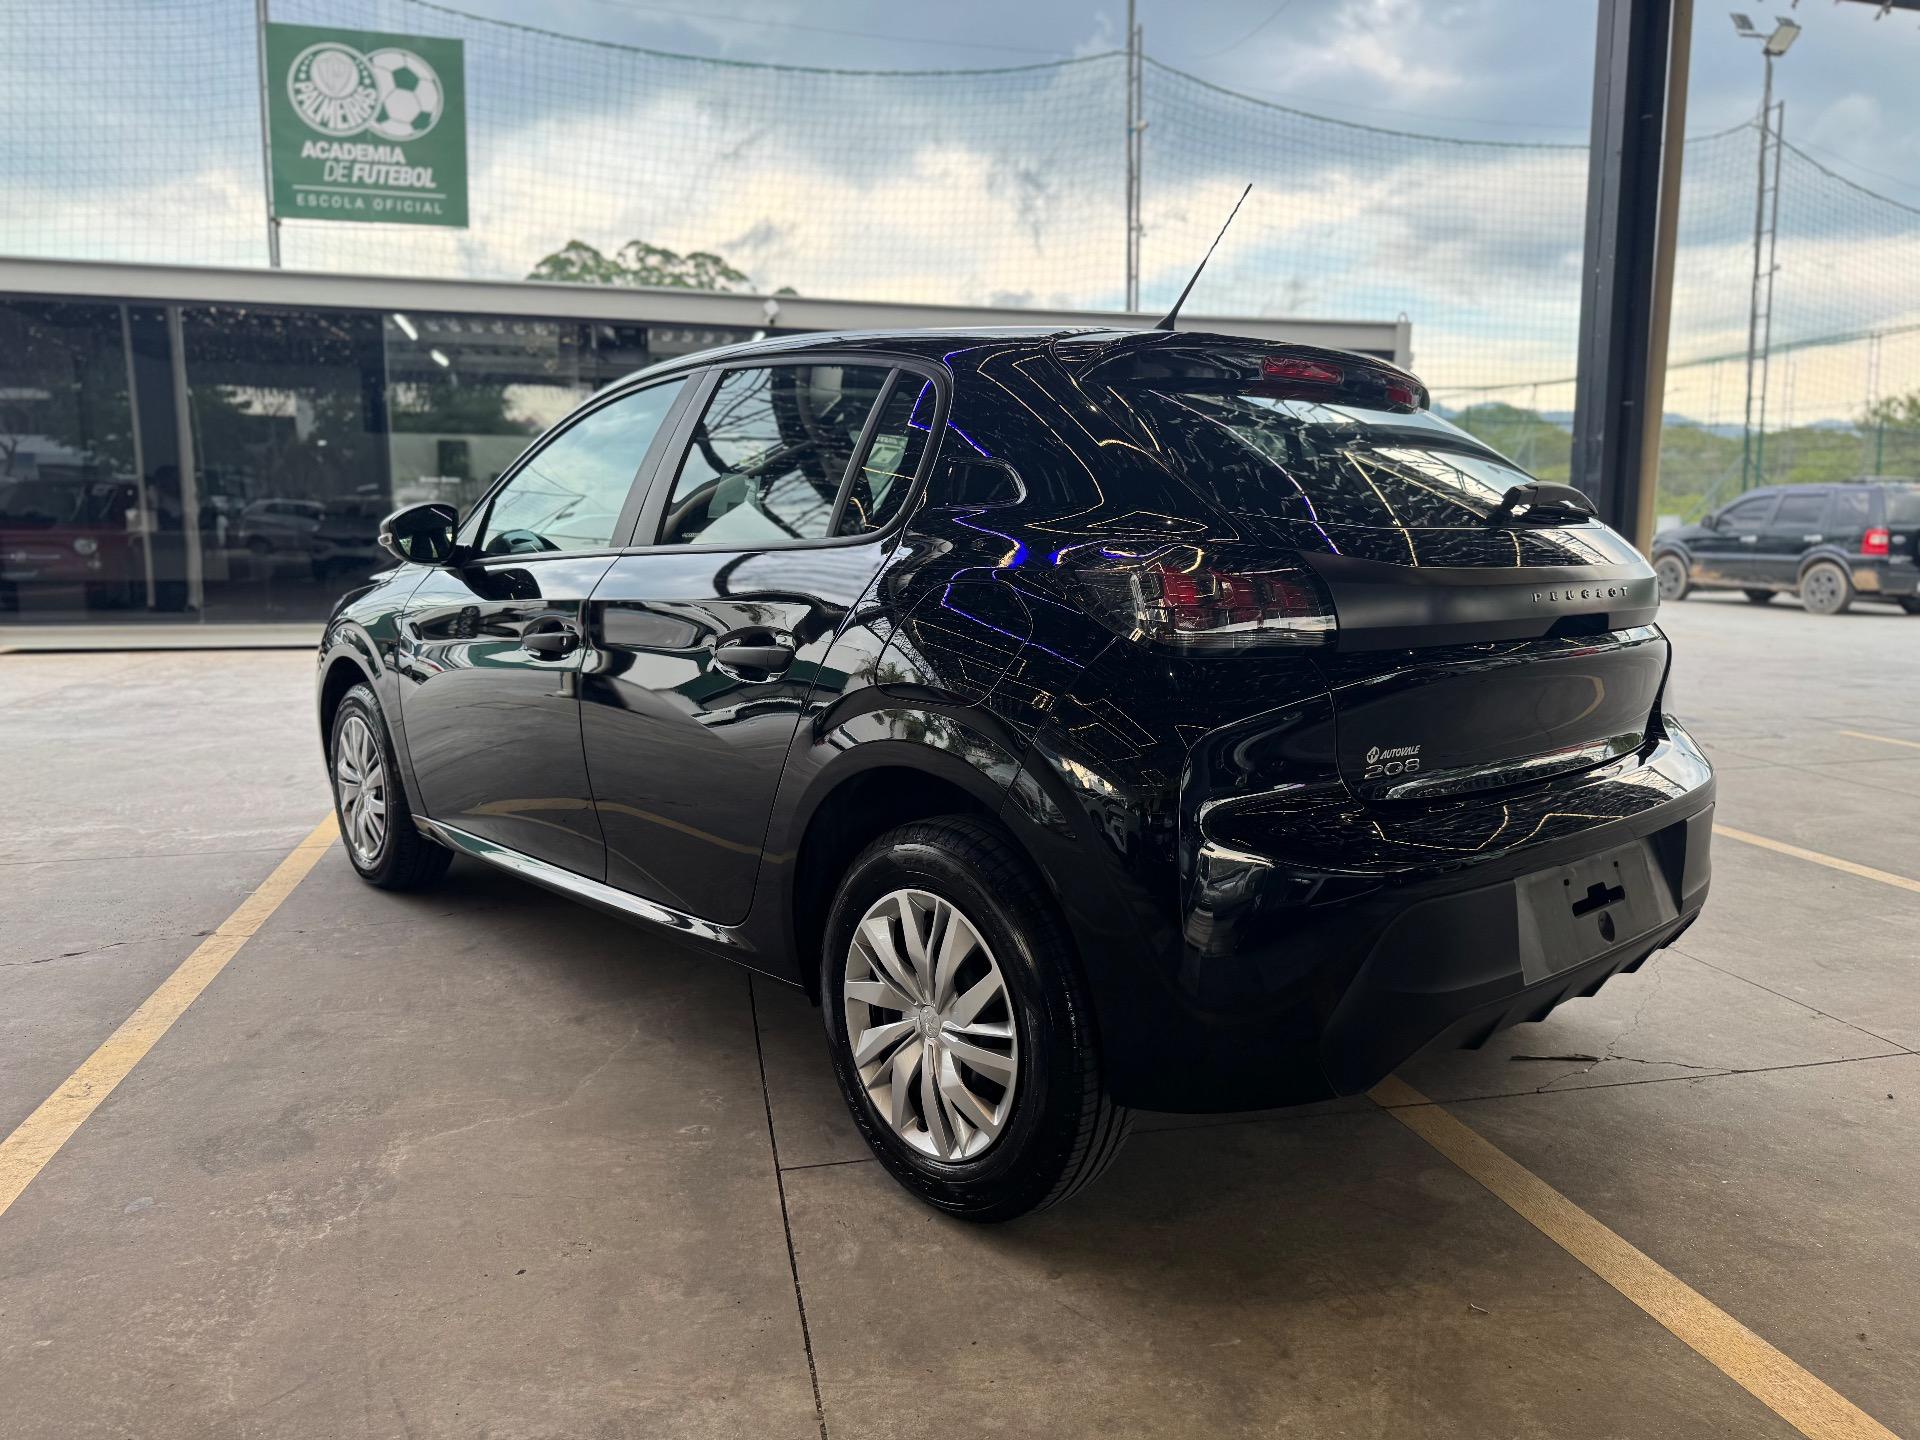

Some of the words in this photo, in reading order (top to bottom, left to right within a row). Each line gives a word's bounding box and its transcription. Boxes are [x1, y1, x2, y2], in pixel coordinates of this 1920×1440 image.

[295, 80, 377, 130] PALMEIRAS
[301, 140, 406, 164] ACADEMIA
[323, 160, 349, 182] DE
[352, 164, 437, 188] FUTEBOL
[296, 193, 365, 209] ESCOLA
[373, 198, 443, 214] OFICIAL
[1532, 586, 1628, 602] PEUGEOT
[1380, 745, 1421, 760] AUTOVALE
[1364, 758, 1420, 780] 208
